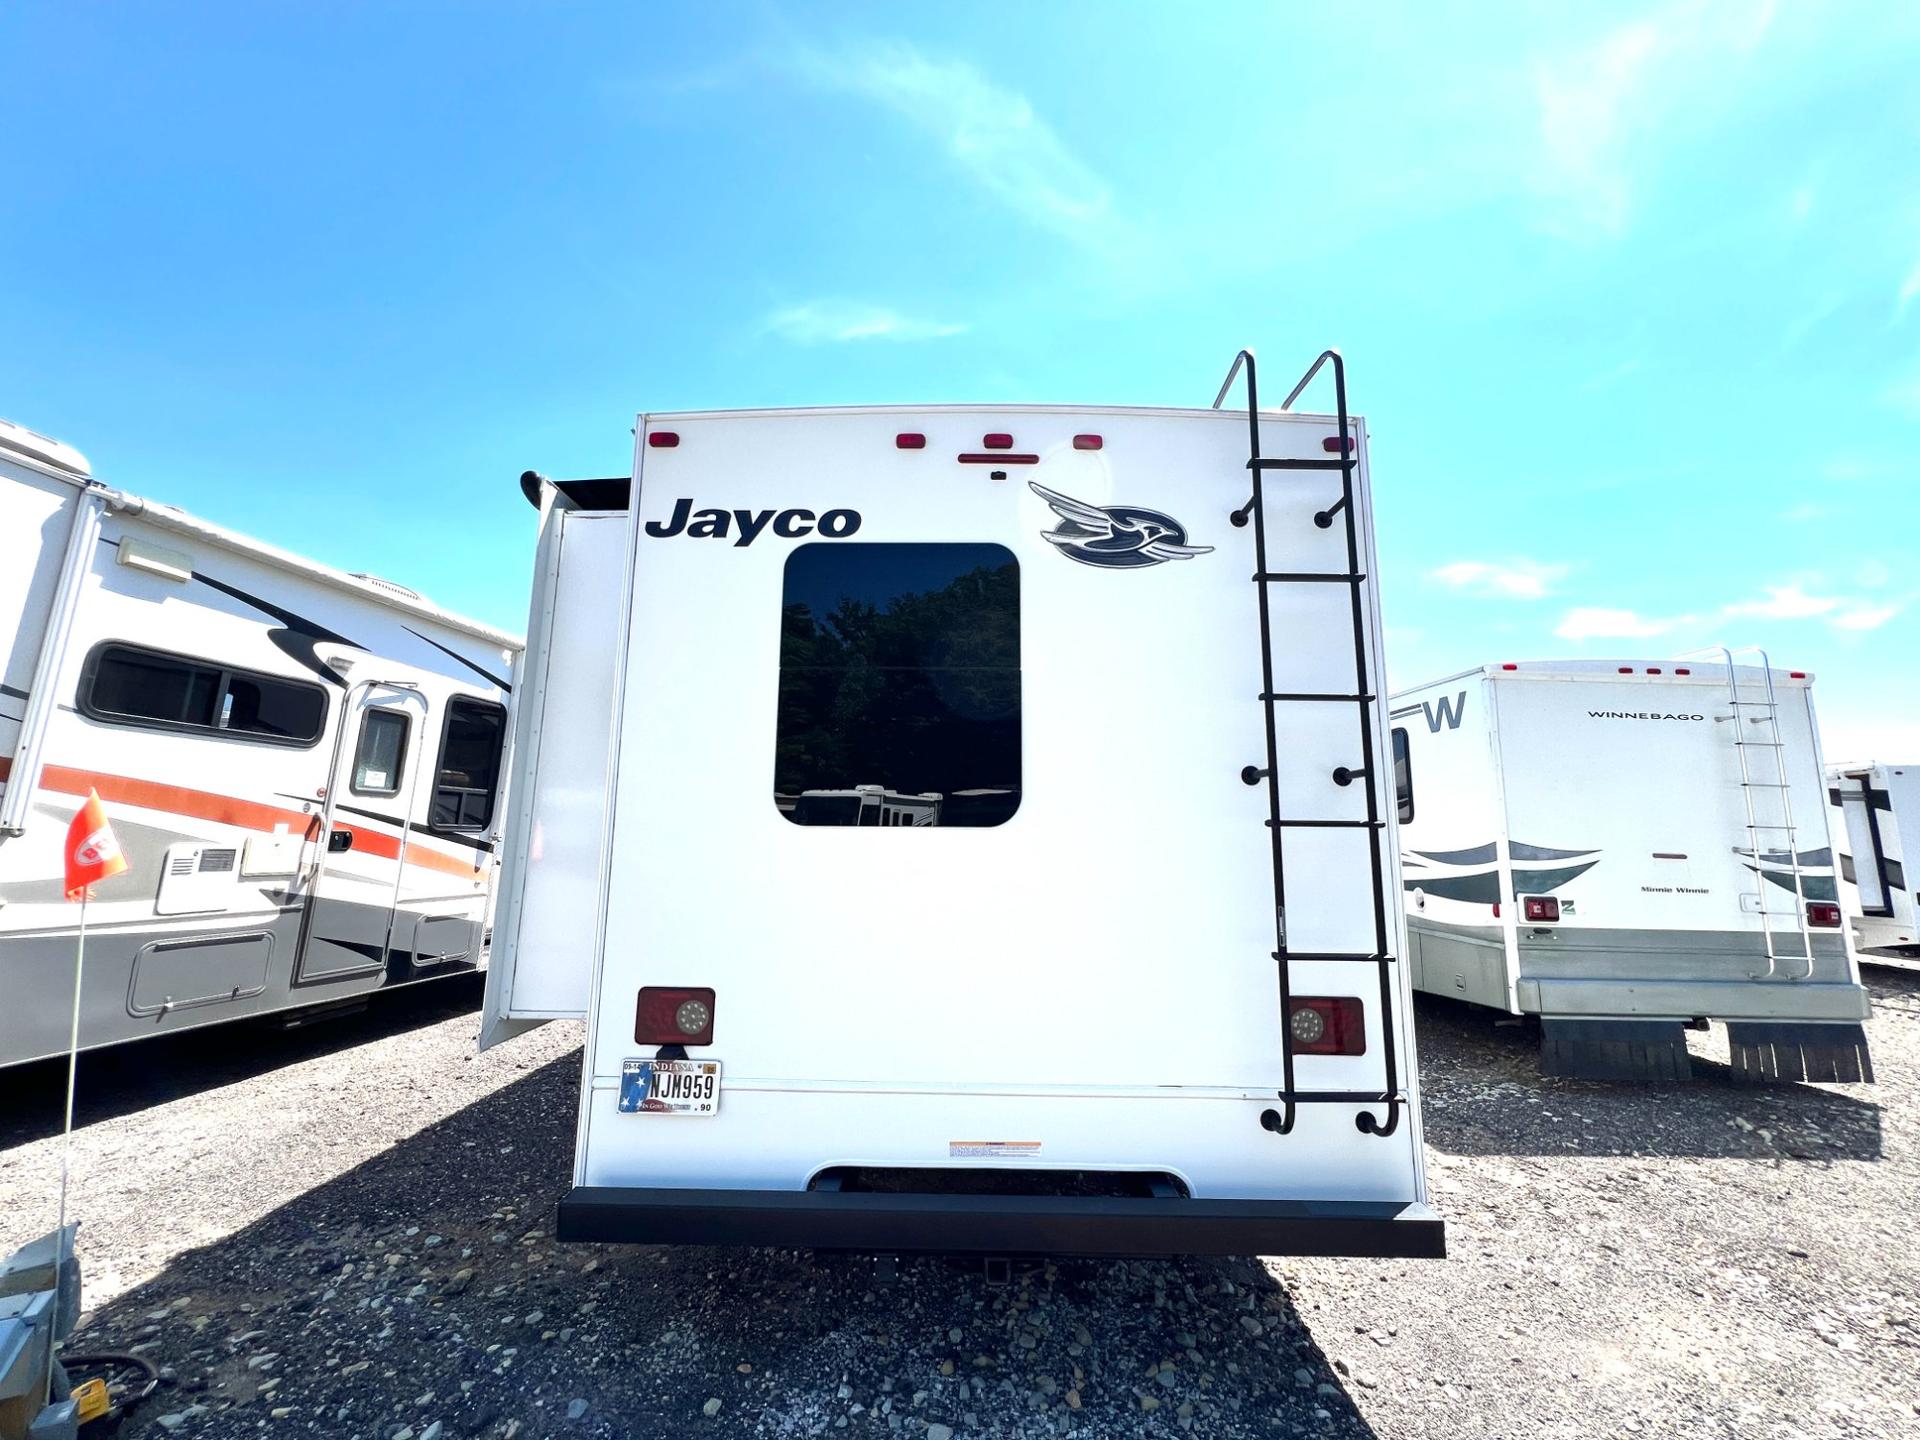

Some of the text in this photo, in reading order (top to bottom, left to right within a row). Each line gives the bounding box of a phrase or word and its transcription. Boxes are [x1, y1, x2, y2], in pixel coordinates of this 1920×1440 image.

[645, 498, 862, 547] Jayco
[1422, 691, 1467, 733] W
[1588, 711, 1704, 721] WINNEBAGO
[648, 1062, 694, 1071] INDIANA
[650, 1074, 714, 1099] NJM959
